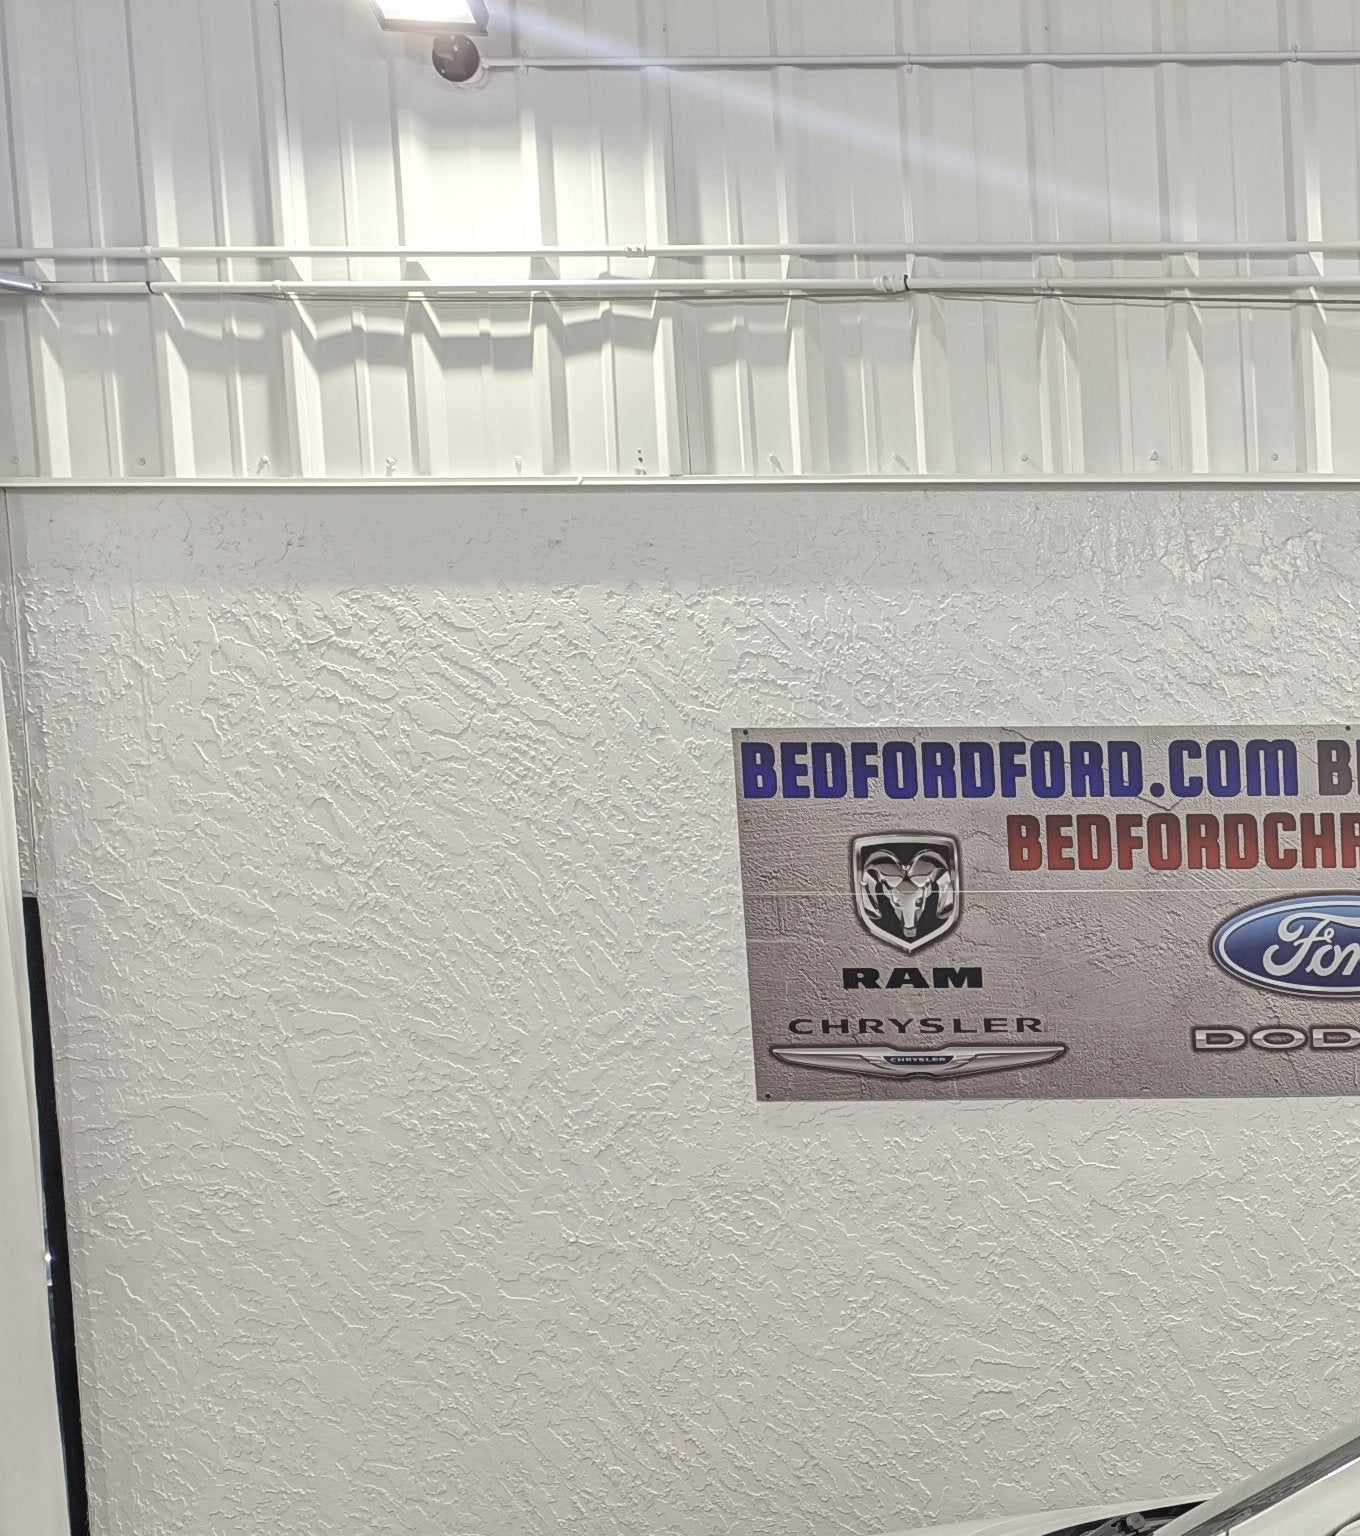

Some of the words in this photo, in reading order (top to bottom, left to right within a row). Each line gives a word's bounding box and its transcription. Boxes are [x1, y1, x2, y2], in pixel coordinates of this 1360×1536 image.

[741, 739, 1298, 798] BEDFORDFORD.COM
[842, 966, 984, 990] RAM
[788, 1017, 1043, 1035] CHRYSLER
[890, 1056, 948, 1064] CHRYSLER
